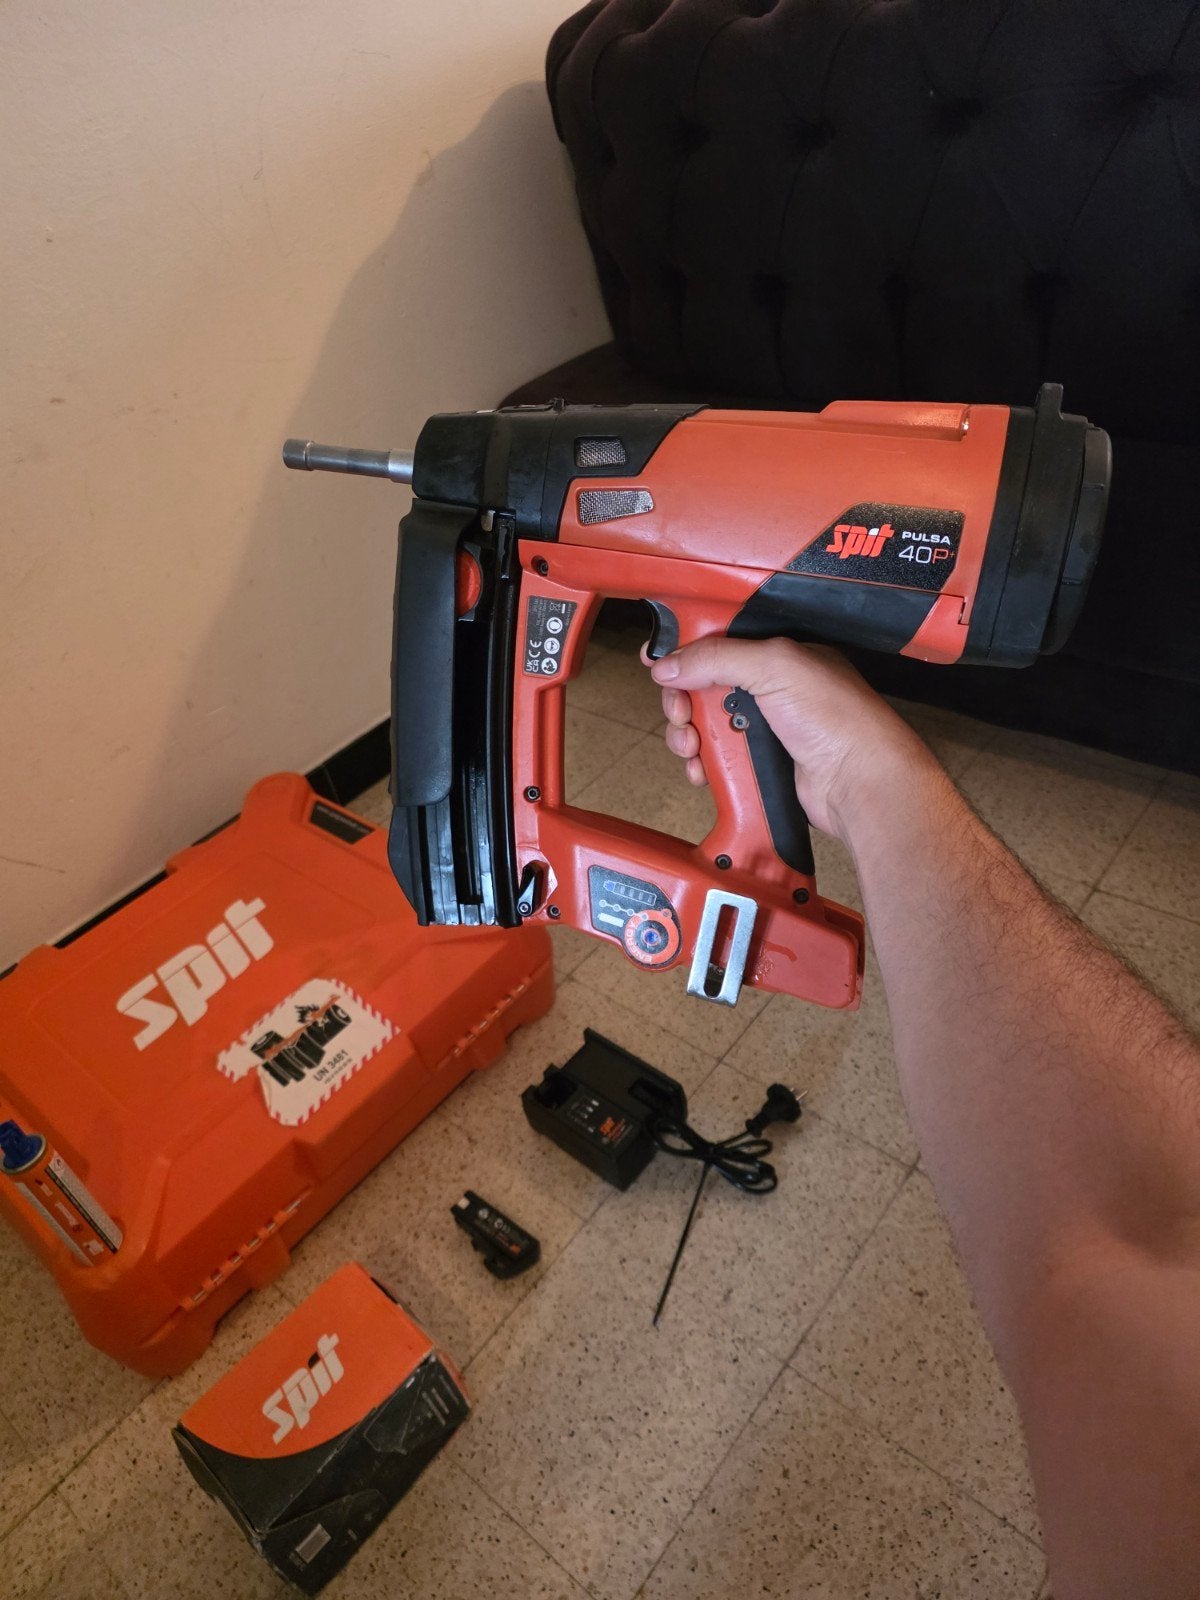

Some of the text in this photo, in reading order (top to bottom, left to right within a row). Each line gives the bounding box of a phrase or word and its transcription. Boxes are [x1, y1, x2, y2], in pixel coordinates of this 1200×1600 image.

[902, 531, 951, 545] PULSA
[526, 659, 533, 672] UK
[313, 1067, 329, 1081] UN
[328, 1049, 348, 1069] 3481
